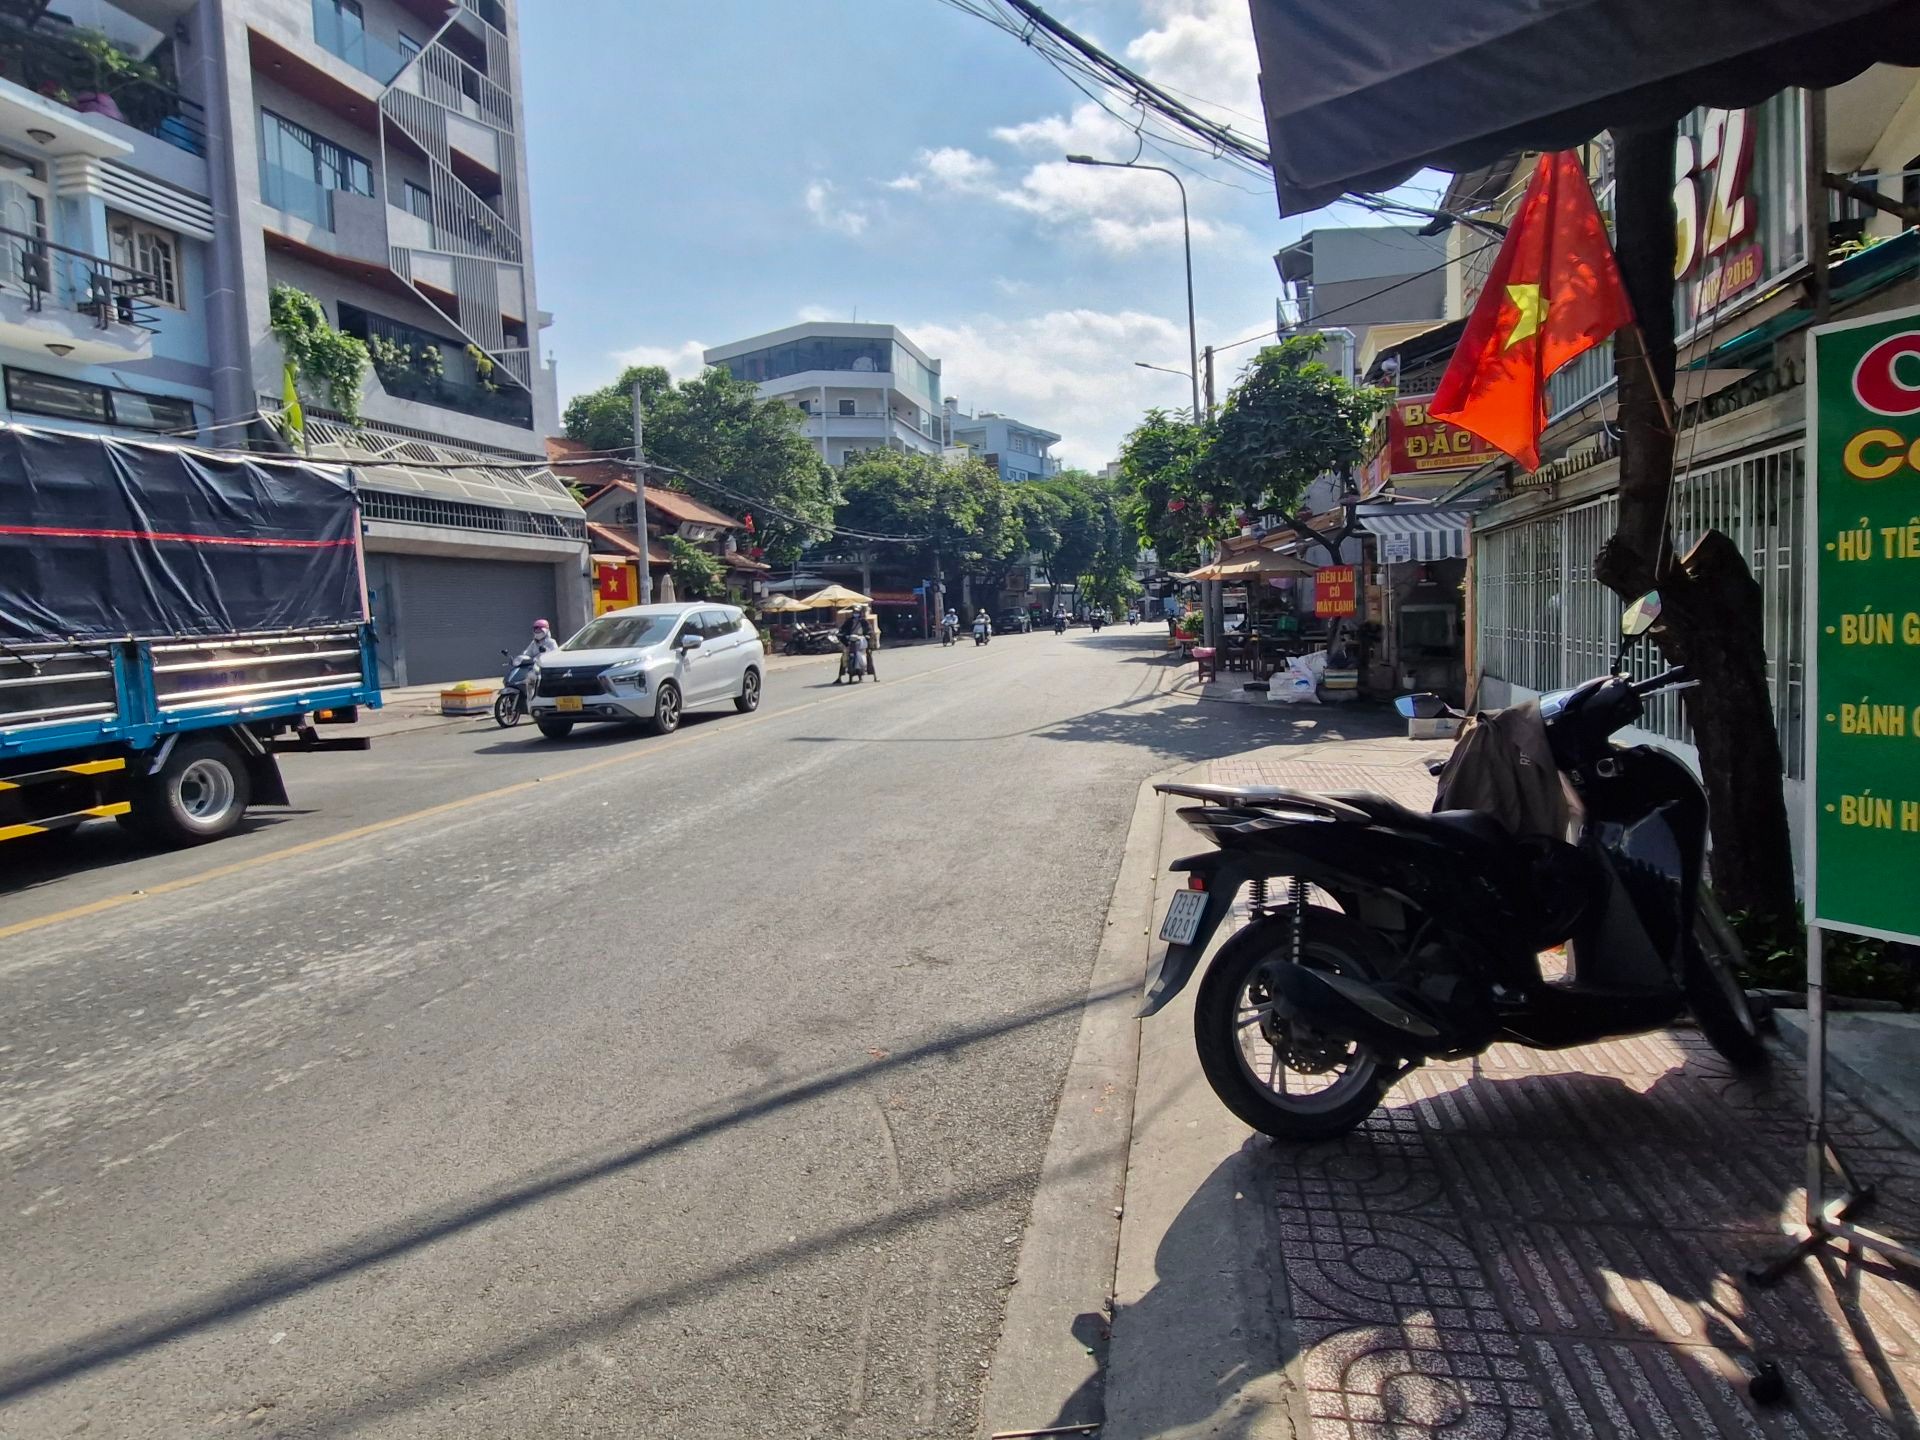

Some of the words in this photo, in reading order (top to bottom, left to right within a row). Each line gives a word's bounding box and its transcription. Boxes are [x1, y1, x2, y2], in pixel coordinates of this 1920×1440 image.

[1727, 253, 1754, 289] 2015
[1407, 424, 1472, 458] ĐẮC
[1838, 517, 1872, 562] HỦ
[1841, 605, 1894, 645] BÚN
[1841, 696, 1905, 737] BÁNH
[1840, 789, 1893, 830] BÚN
